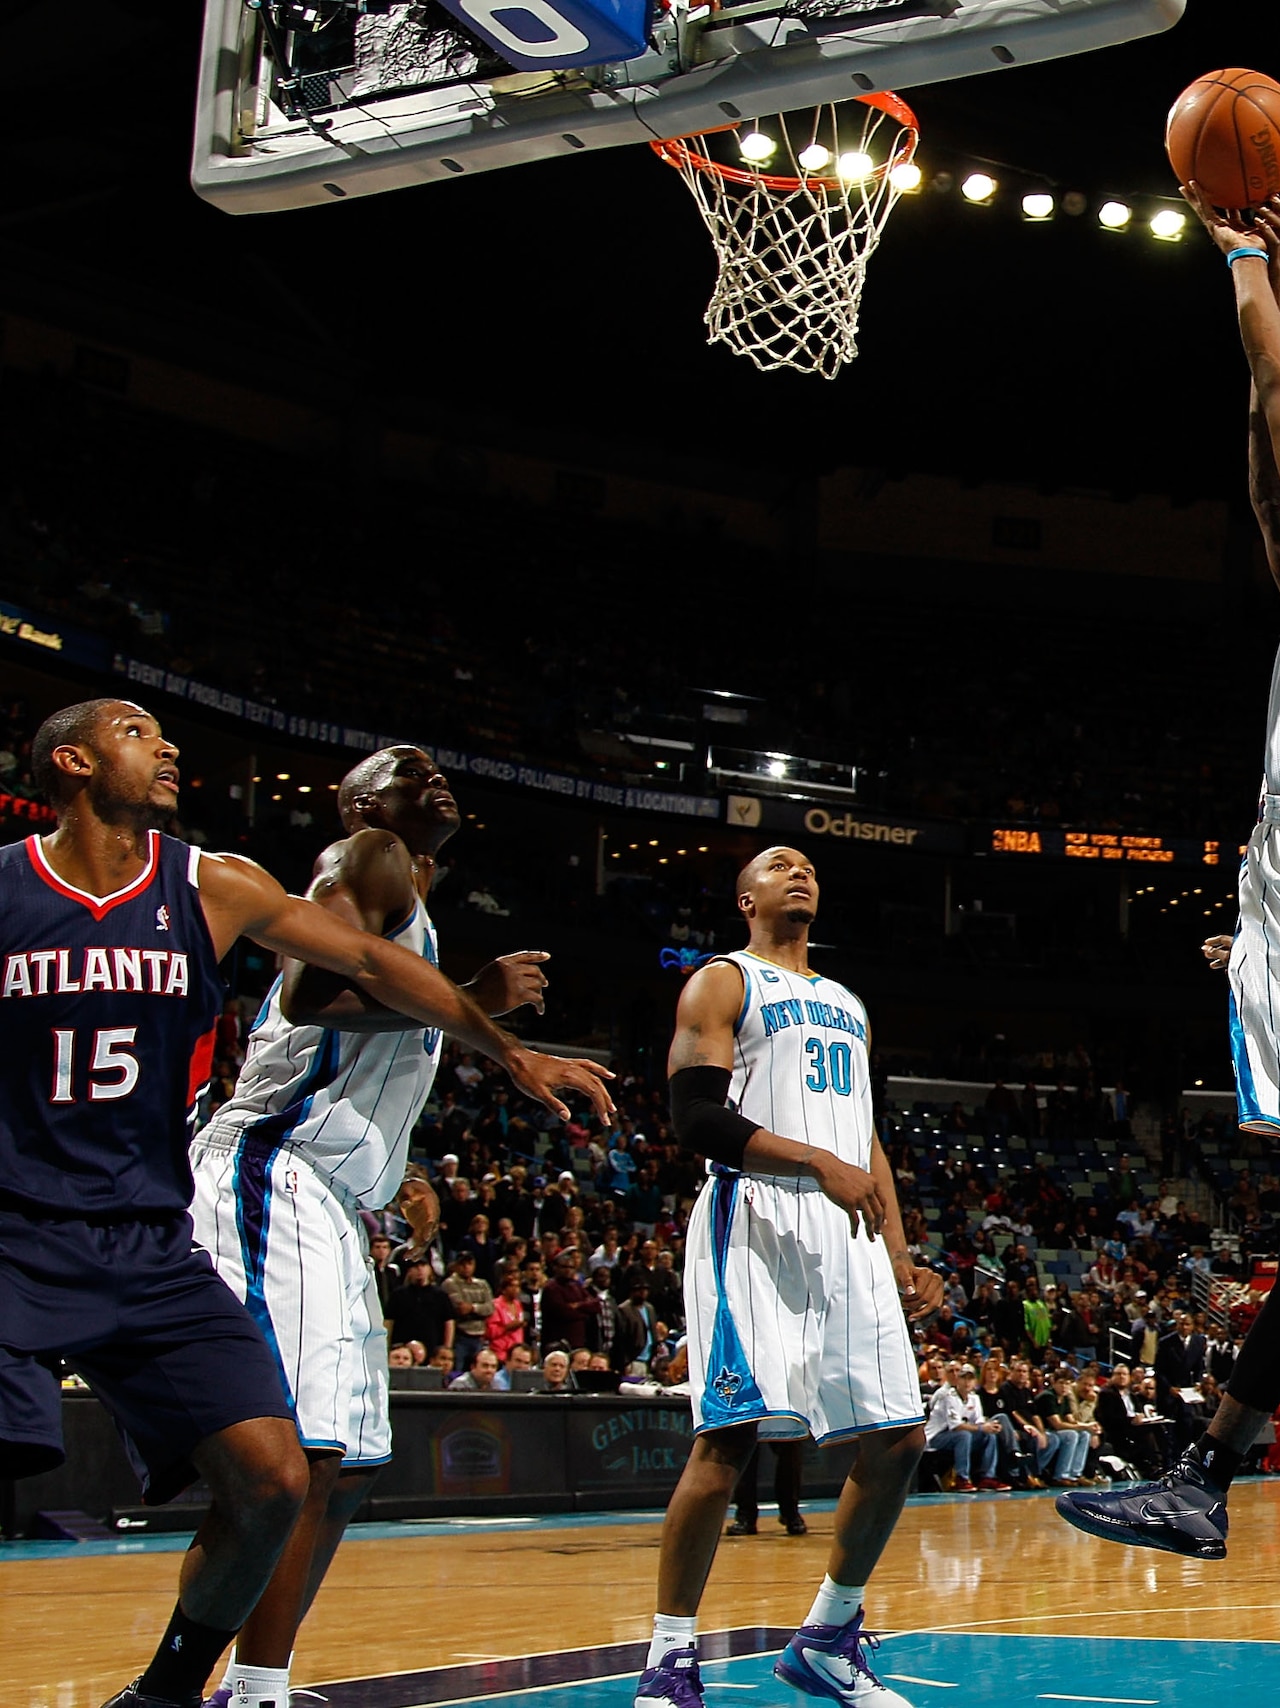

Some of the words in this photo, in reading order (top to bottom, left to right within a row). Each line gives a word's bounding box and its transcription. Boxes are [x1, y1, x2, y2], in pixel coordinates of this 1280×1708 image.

[128, 659, 166, 690] EVENT
[188, 680, 245, 717] PROBLEMS
[244, 700, 272, 727] TEXT
[272, 709, 287, 731] TO
[343, 728, 375, 750] WITH
[437, 750, 467, 772] NOLA
[518, 766, 576, 796] FOLLOWED
[576, 780, 592, 798] BY
[593, 784, 624, 806] ISSUE
[636, 790, 696, 816] LOCATION
[804, 808, 919, 845] Ochsner
[2, 946, 189, 998] ATLANTA
[760, 998, 805, 1037] NEW
[51, 1025, 139, 1103] 15
[805, 1037, 851, 1096] 30
[592, 1408, 694, 1451] GENTLEM
[632, 1446, 677, 1475] JACK
[674, 1656, 695, 1669] NIKE
